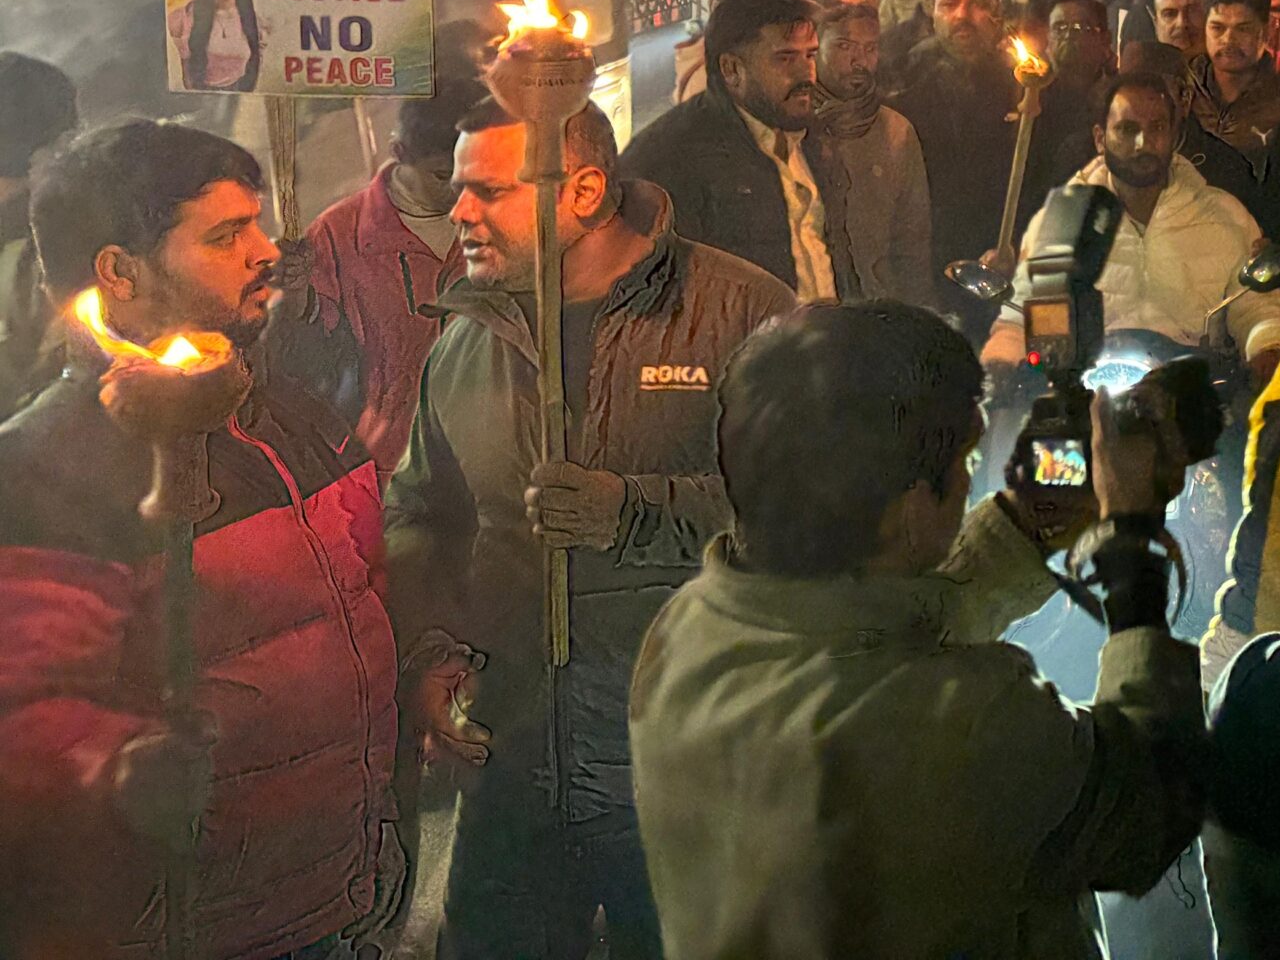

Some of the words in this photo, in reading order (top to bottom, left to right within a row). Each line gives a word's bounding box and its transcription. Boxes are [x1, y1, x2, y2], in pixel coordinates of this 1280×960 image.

[299, 15, 374, 52] NO
[284, 56, 396, 86] PEACE
[640, 365, 709, 384] ROKA
